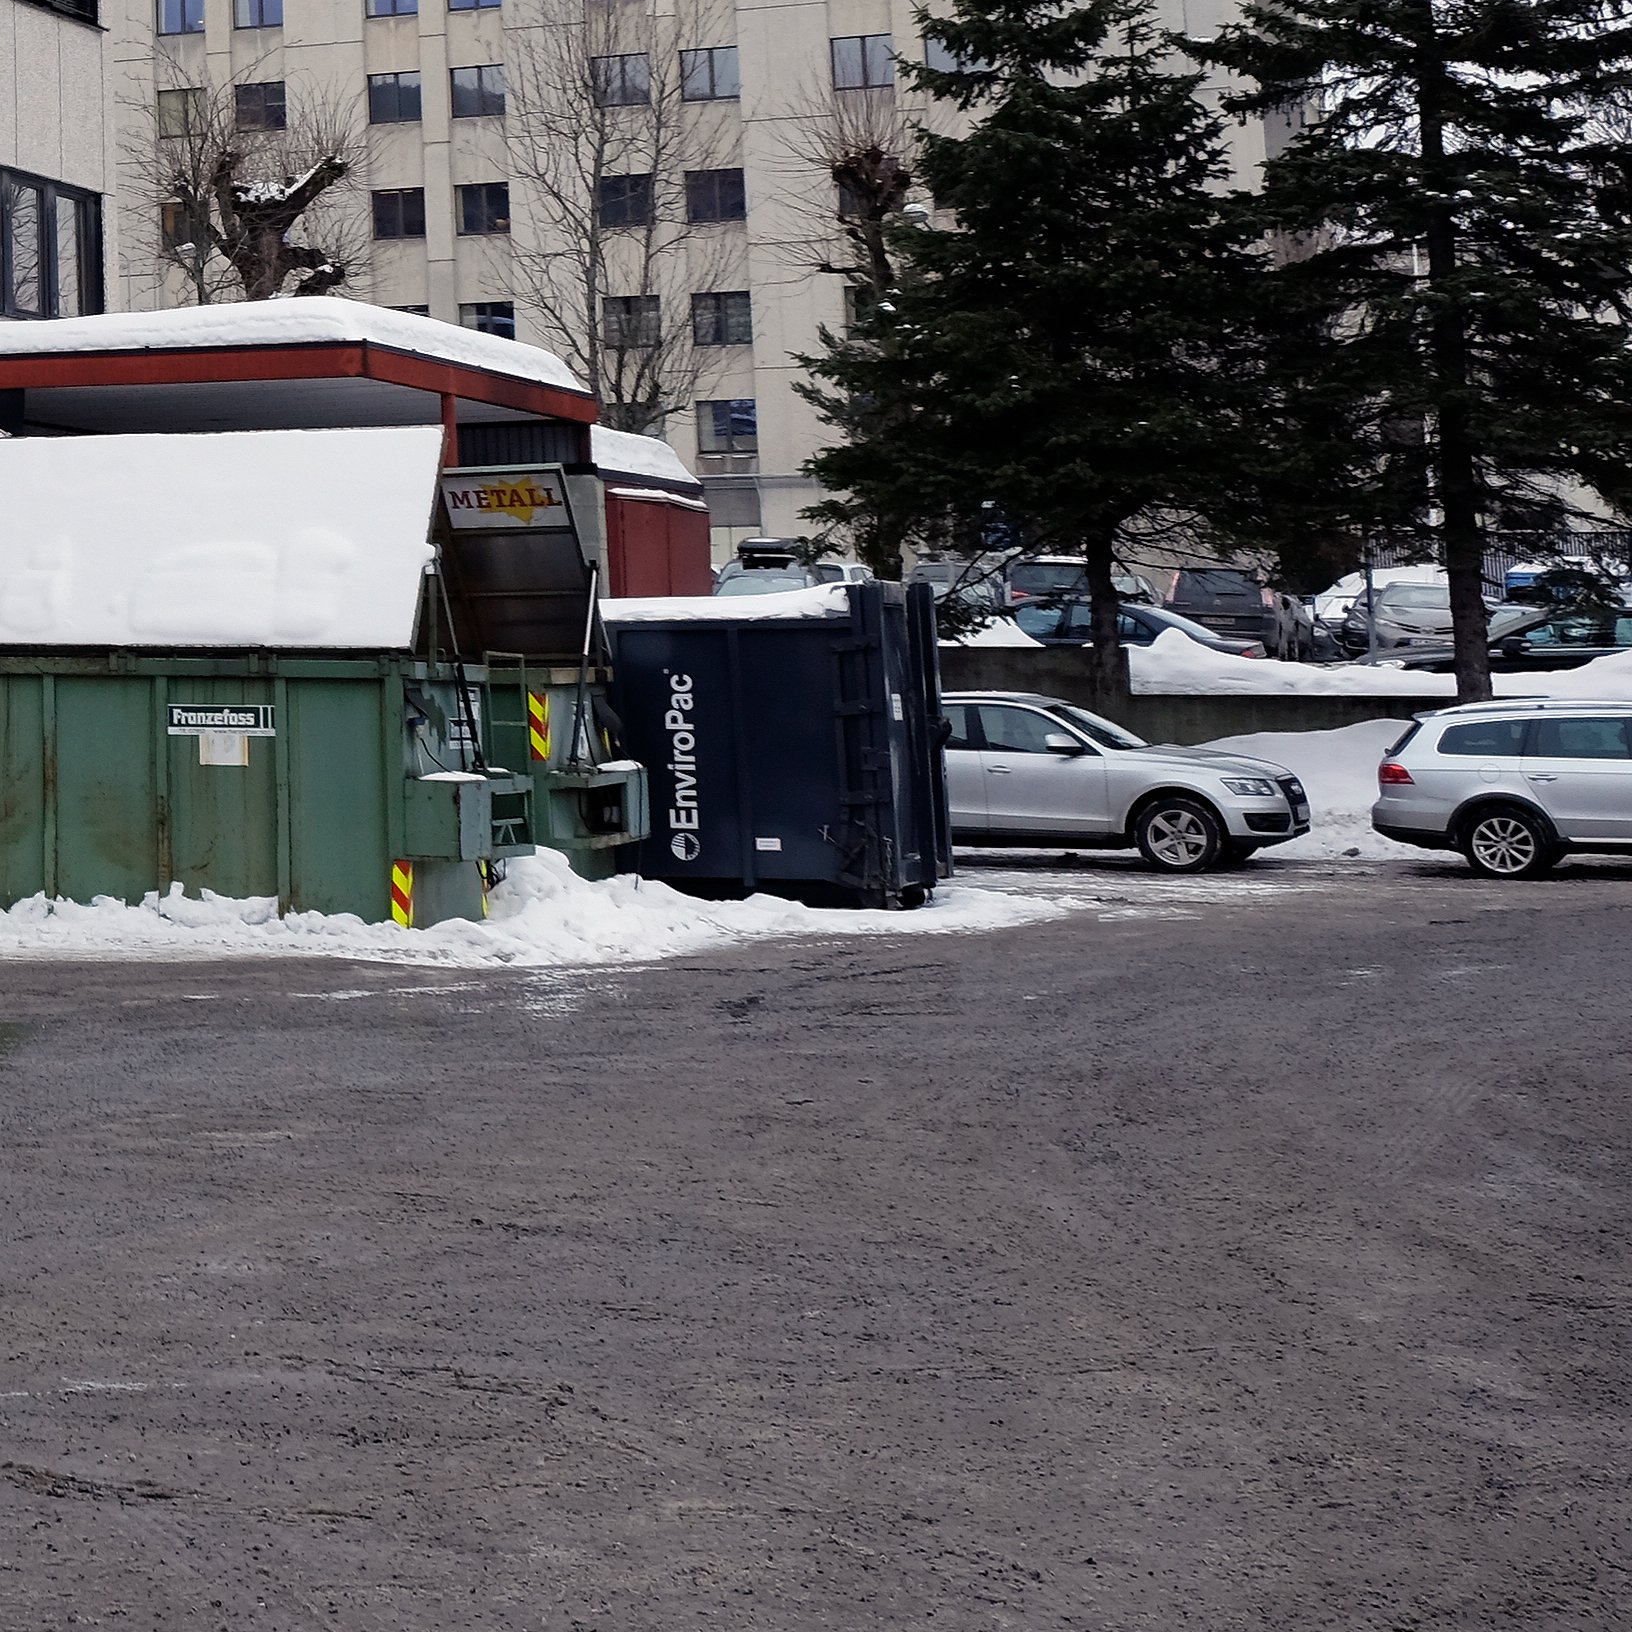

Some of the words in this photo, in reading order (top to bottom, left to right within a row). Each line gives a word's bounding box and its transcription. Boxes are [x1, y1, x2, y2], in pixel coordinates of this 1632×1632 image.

[448, 488, 563, 509] METALL
[172, 708, 256, 726] Franzefoss
[664, 673, 700, 830] EnviroPac
